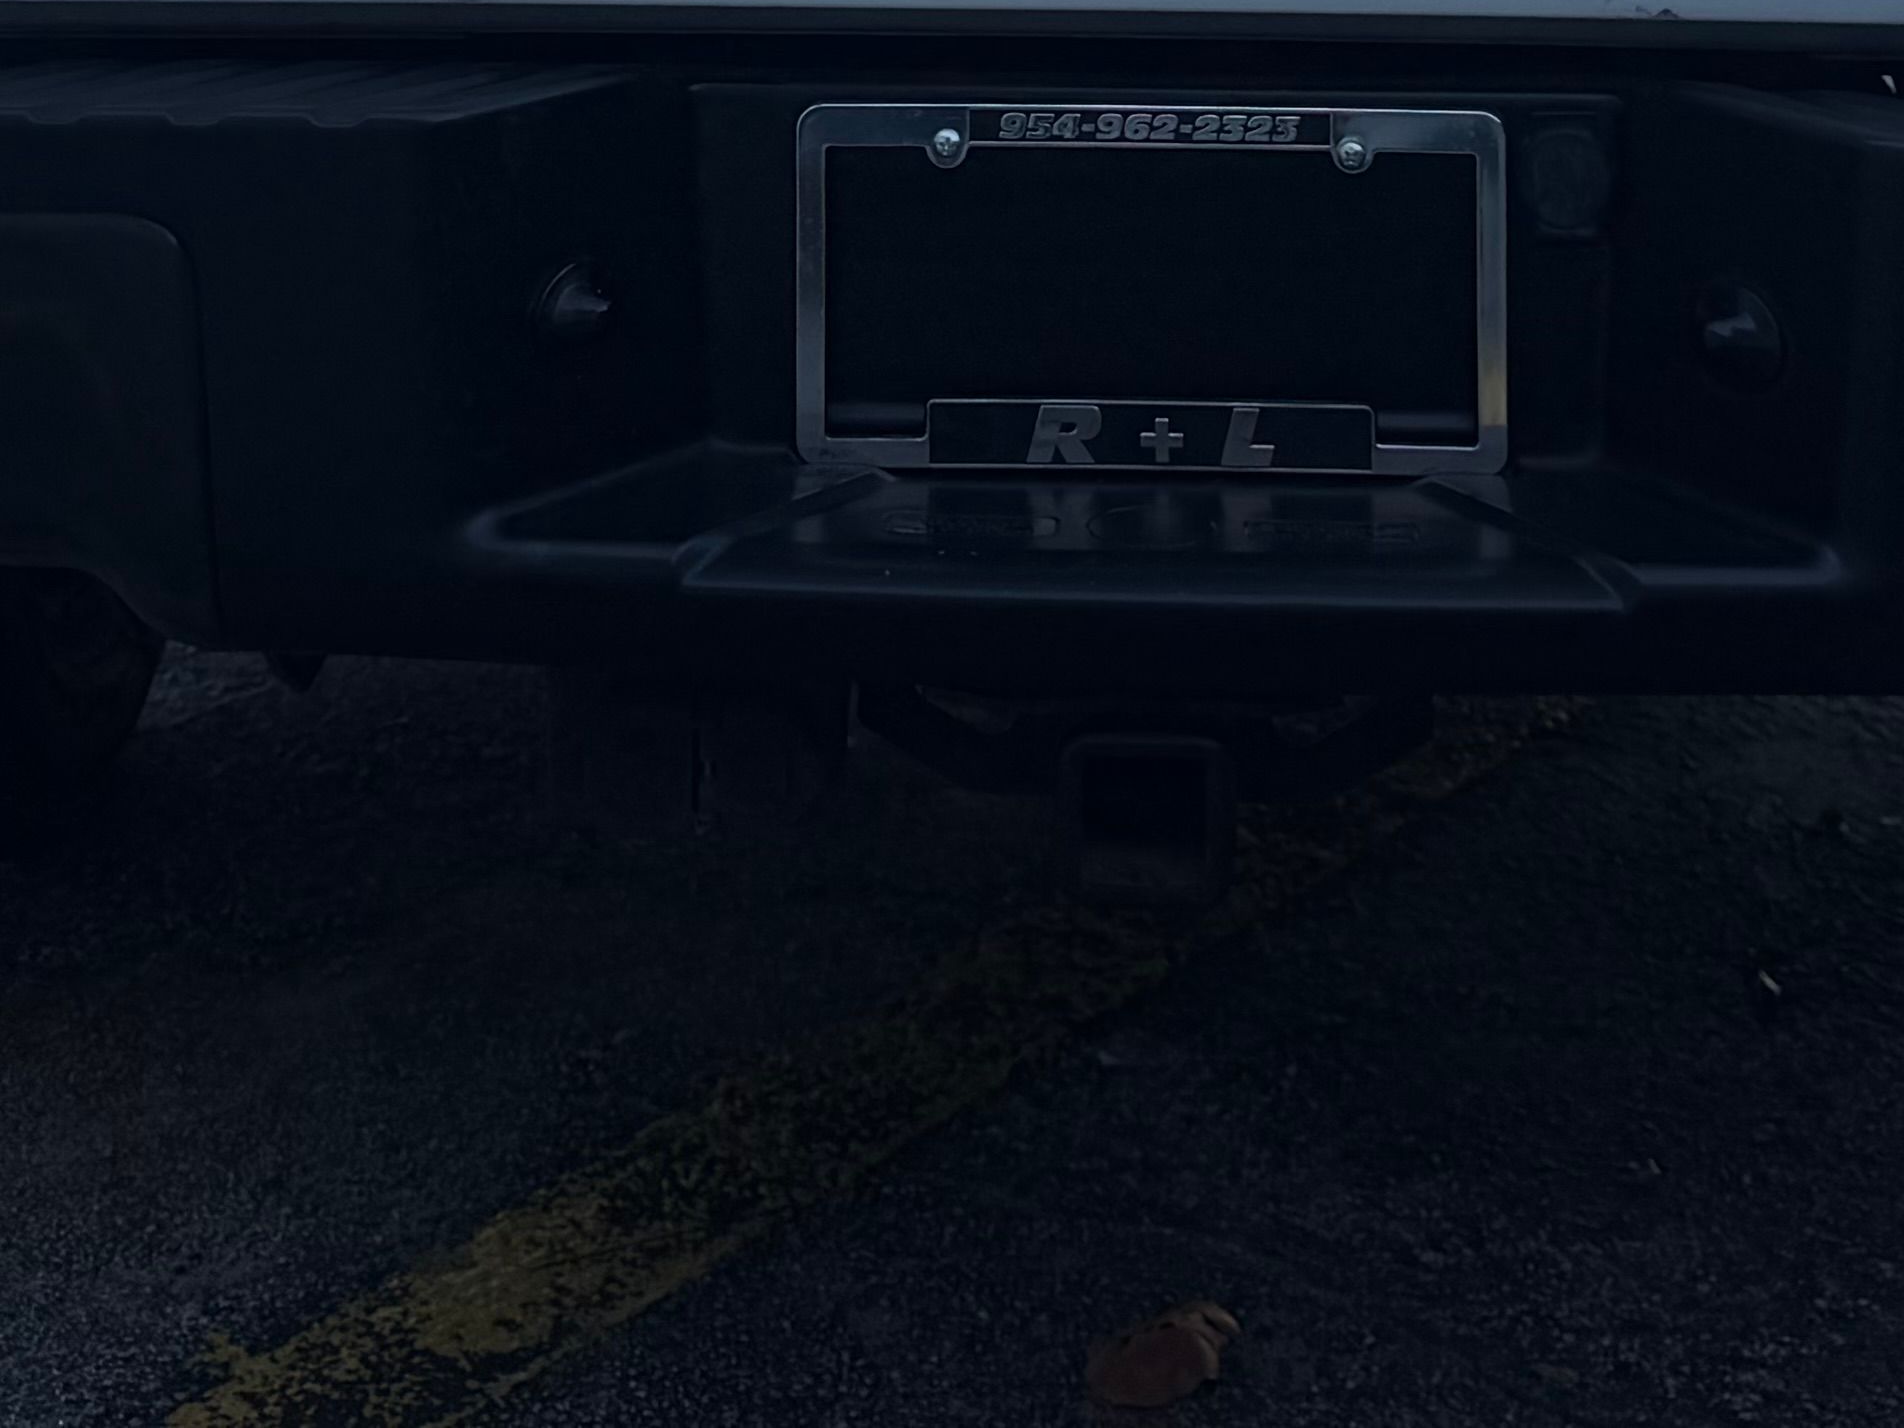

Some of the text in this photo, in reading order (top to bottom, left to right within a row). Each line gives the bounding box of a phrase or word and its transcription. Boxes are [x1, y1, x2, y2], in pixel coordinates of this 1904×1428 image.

[999, 112, 1301, 142] 954-962-2323
[1026, 405, 1102, 464] R
[1221, 407, 1277, 467] L
